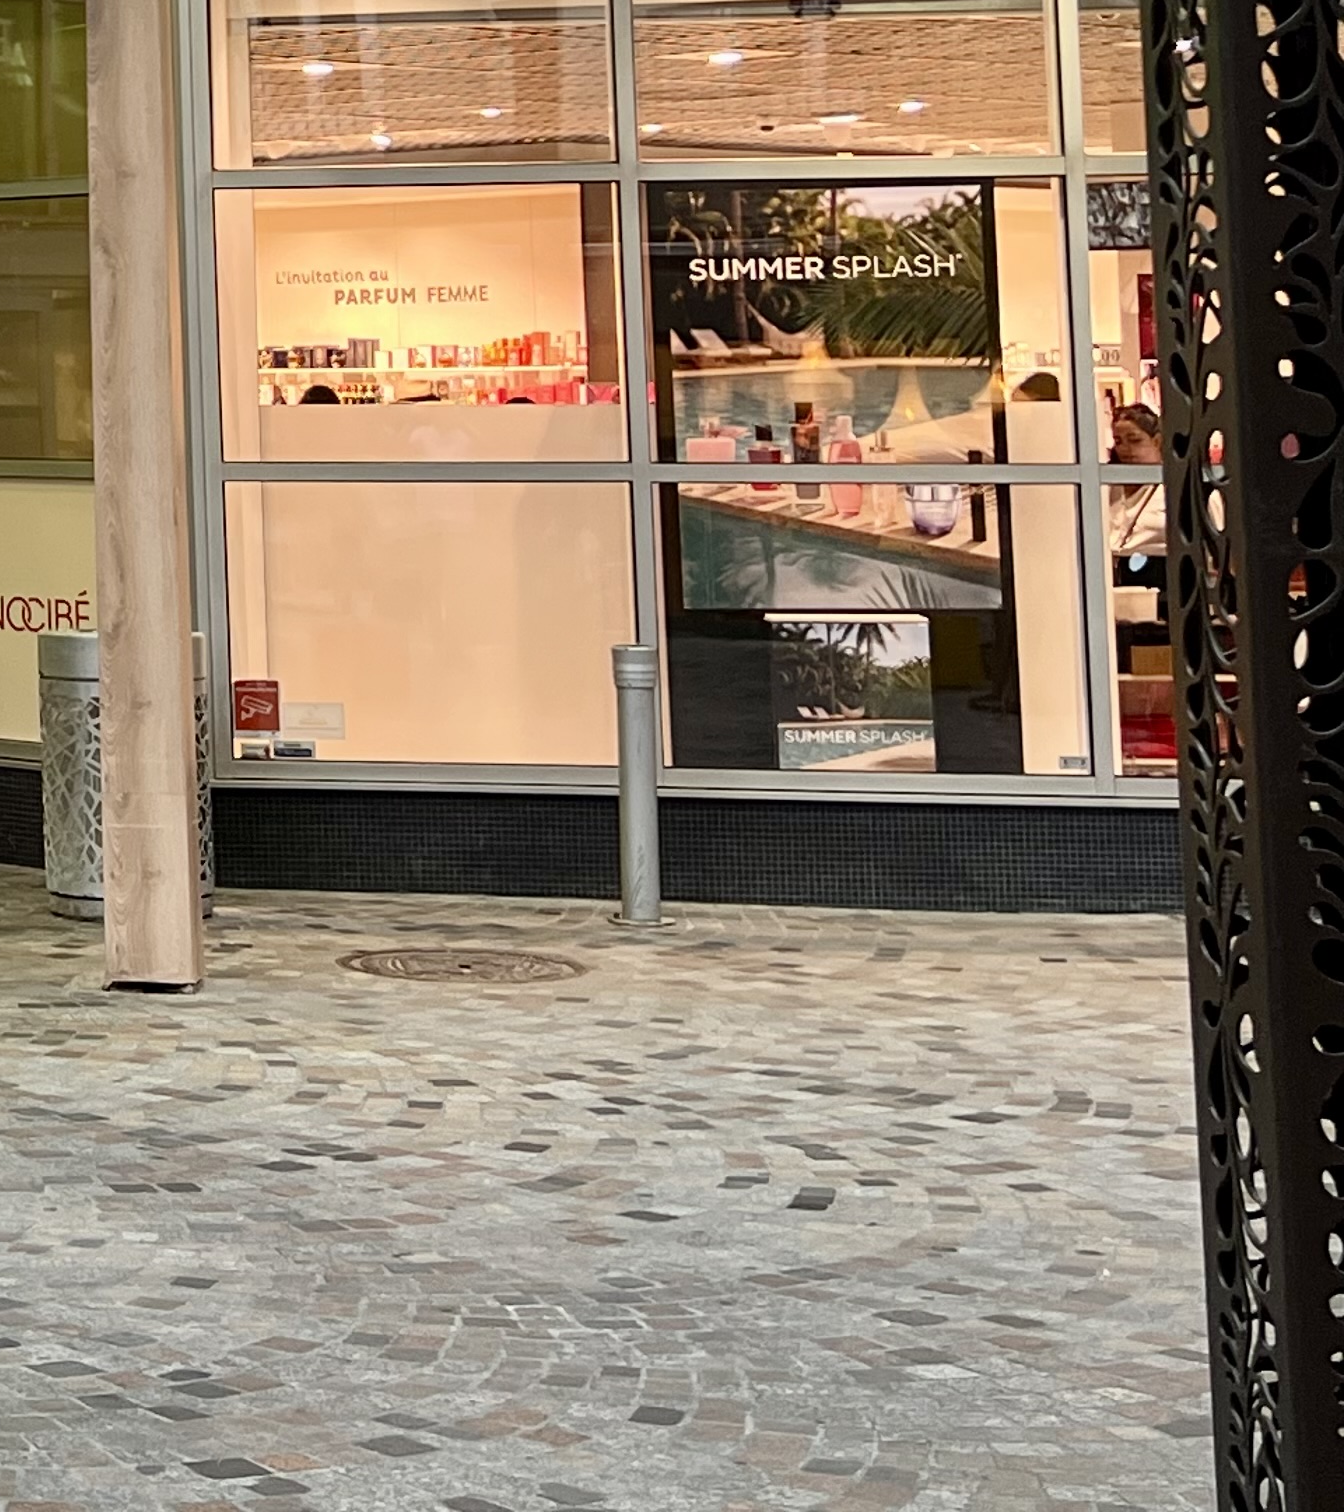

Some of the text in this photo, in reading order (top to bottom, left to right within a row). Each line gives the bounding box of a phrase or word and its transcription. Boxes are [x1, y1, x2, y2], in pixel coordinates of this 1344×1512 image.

[275, 269, 389, 286] L'invitation au
[688, 256, 825, 281] SUMMER
[334, 285, 490, 305] PARFUM FEMME
[783, 729, 857, 745] SUMMER
